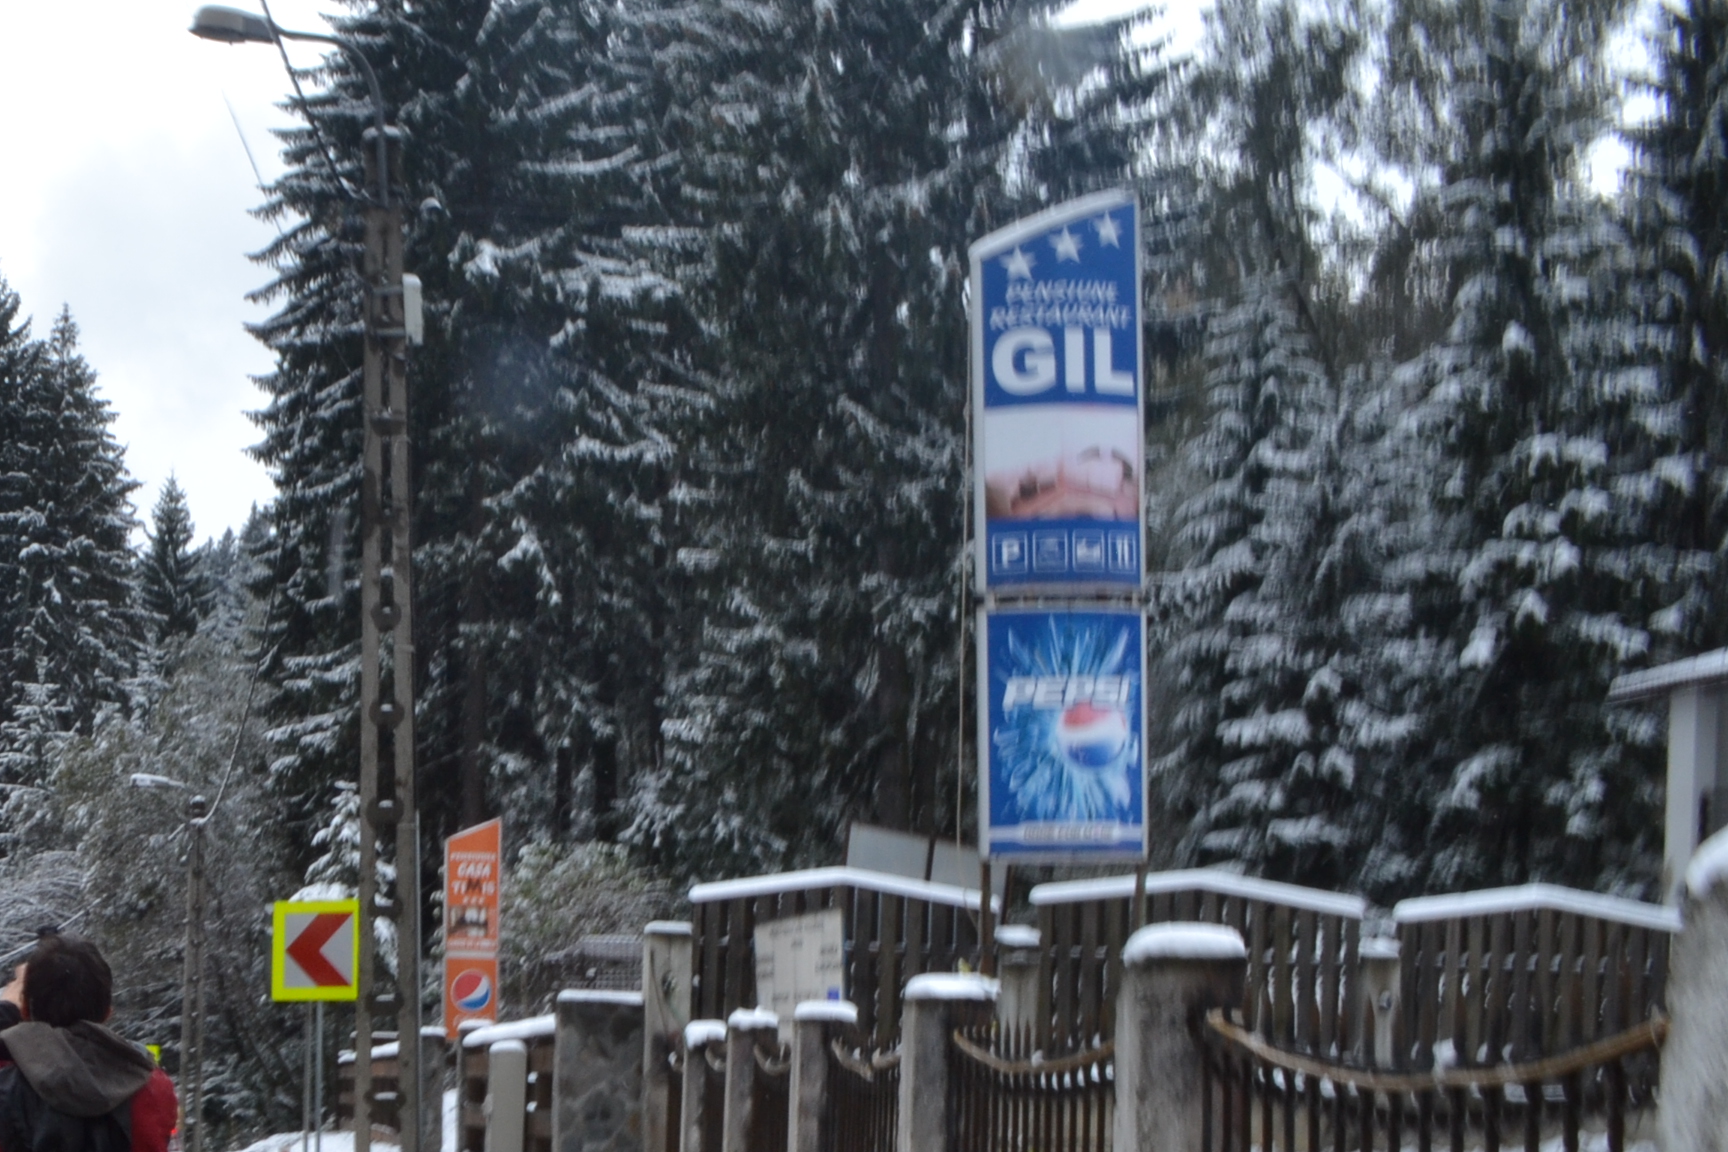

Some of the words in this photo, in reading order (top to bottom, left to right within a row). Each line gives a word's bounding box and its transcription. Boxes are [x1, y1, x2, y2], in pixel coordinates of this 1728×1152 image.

[1006, 280, 1117, 304] PENSIUNE
[990, 303, 1131, 330] RESTAURANT
[992, 326, 1134, 396] GIL
[1003, 675, 1131, 711] PEPSI
[457, 862, 491, 878] CASA
